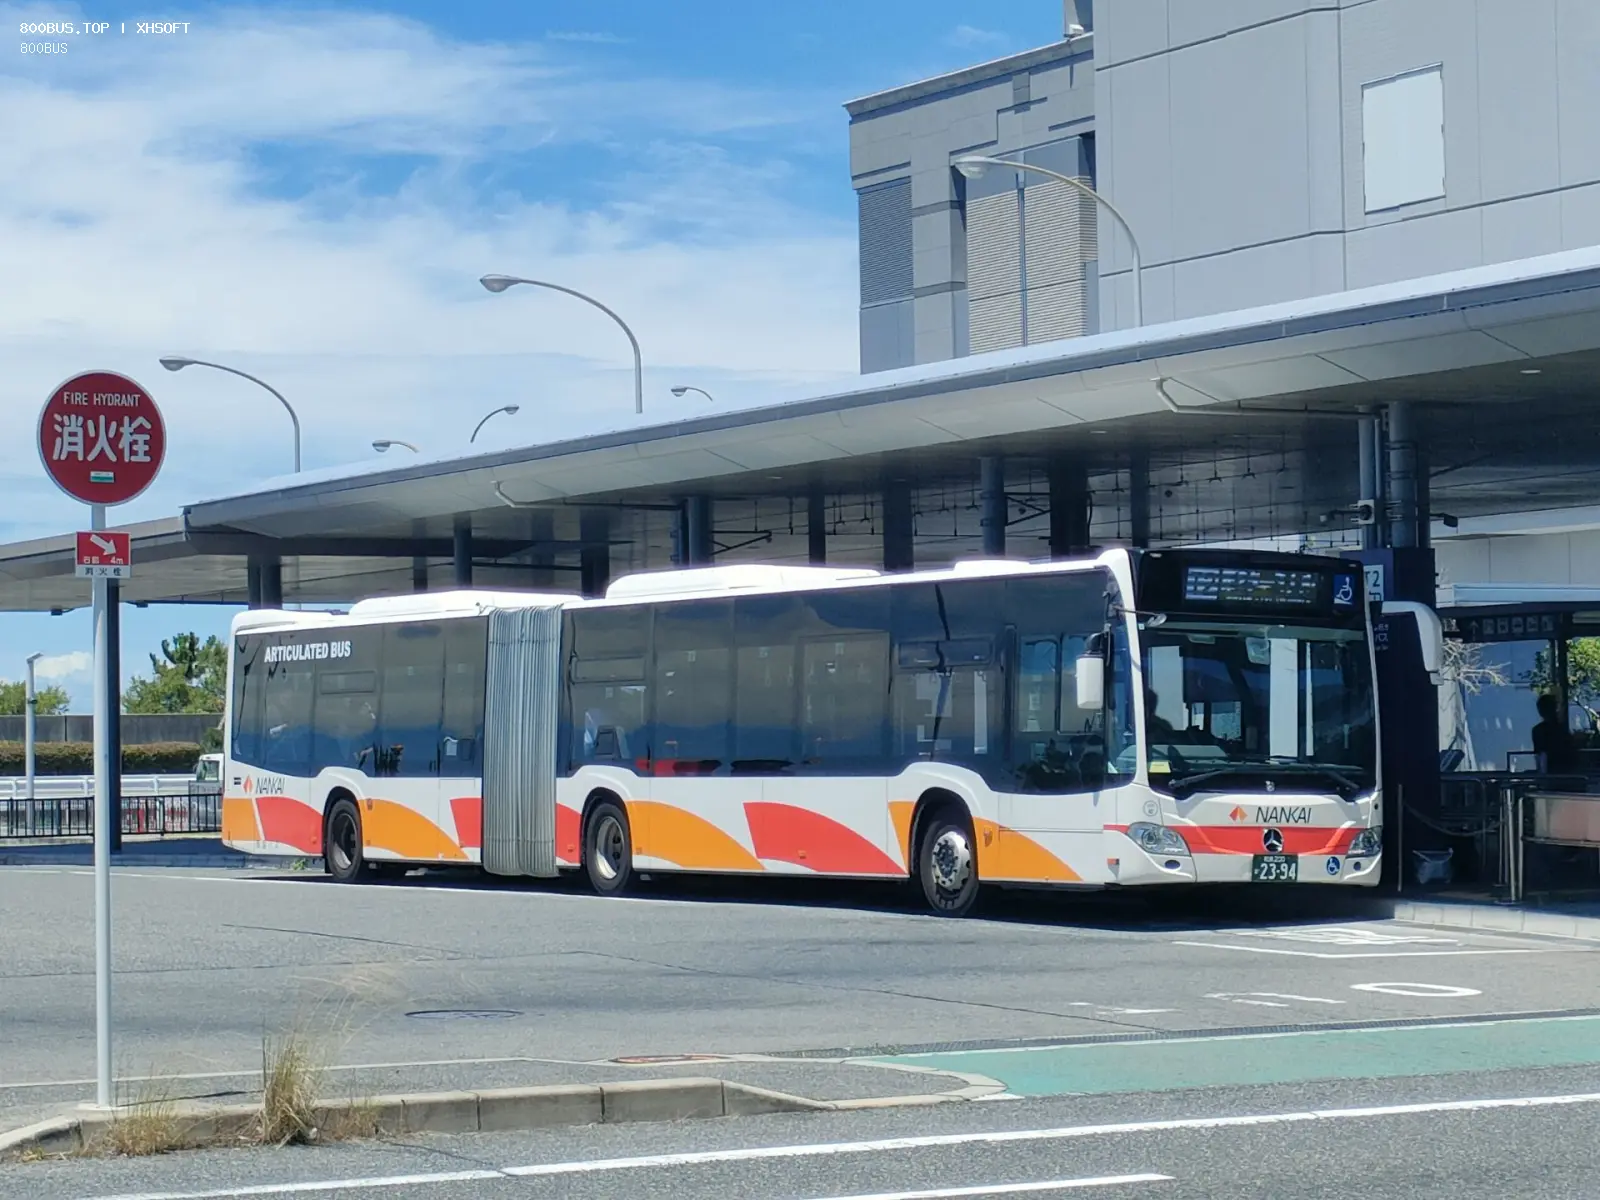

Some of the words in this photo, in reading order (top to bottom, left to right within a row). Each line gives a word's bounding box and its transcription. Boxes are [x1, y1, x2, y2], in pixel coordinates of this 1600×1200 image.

[63, 391, 89, 406] FIRE
[93, 392, 141, 408] HYDRANT
[52, 413, 152, 463] 消火栓
[264, 643, 329, 663] ARTICULATED
[330, 640, 351, 659] BUS
[255, 776, 286, 795] NANKAI
[1255, 806, 1312, 824] NANKAI
